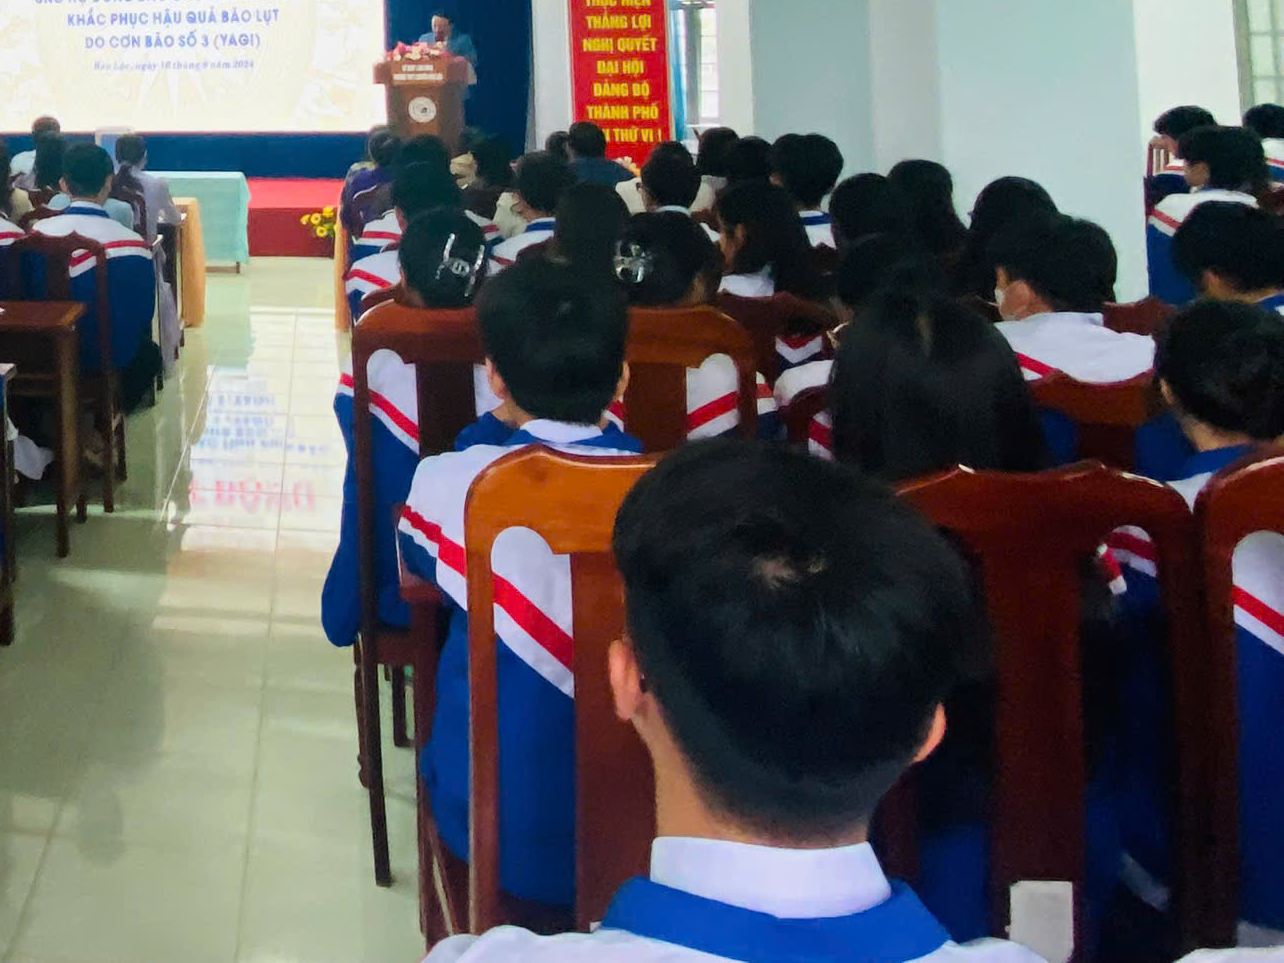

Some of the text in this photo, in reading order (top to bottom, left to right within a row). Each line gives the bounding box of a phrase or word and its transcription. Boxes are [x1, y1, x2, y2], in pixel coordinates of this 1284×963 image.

[67, 7, 107, 26] KHẮC
[110, 12, 149, 29] PHỤC
[153, 8, 182, 28] HẬU
[187, 6, 218, 25] QUẢ
[256, 8, 280, 27] LỤT
[84, 36, 105, 48] DO
[108, 34, 141, 48] CƠN
[178, 29, 198, 48] SỐ
[201, 34, 209, 47] 3
[214, 33, 261, 49] (YAGI)
[617, 35, 657, 53] QUYẾT
[587, 101, 659, 120] THÀNH PHỐ
